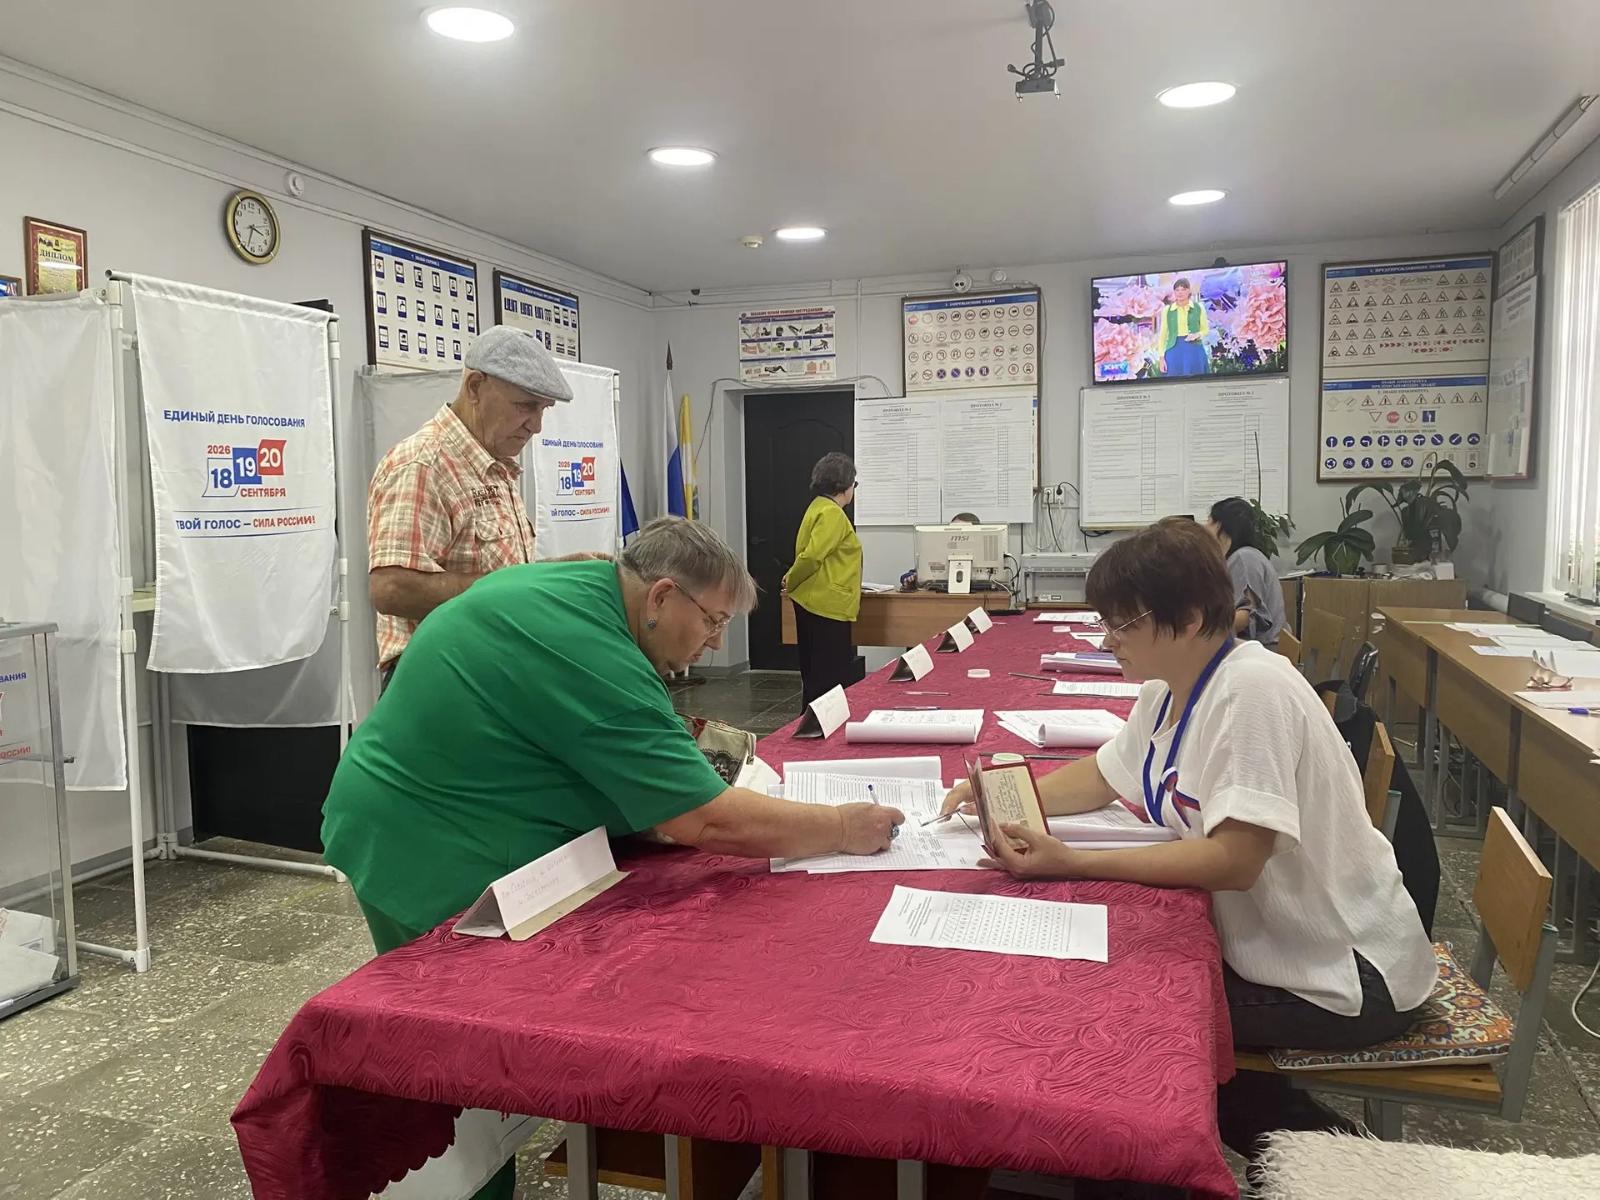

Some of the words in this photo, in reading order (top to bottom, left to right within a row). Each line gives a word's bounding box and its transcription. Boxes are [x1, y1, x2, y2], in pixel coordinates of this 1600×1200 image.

[40, 249, 74, 263] ДИПЛОМ
[163, 409, 215, 423] ЕДИНЫЙ
[217, 413, 245, 425] ДЕНЬ
[207, 445, 231, 455] 2026
[562, 440, 577, 448] ДЕНЬ
[210, 468, 233, 488] 18
[236, 457, 256, 477] 19
[259, 448, 281, 467] 20
[560, 477, 571, 490] 18
[572, 469, 582, 482] 19
[582, 462, 594, 475] 20
[240, 488, 286, 497] СЕНТЯБРЯ
[559, 509, 576, 517] ГОЛОС
[175, 518, 201, 530] ТВОЙ
[204, 520, 241, 529] ГОЛОС
[253, 518, 275, 528] СИЛА
[278, 515, 316, 526] РОССИИ!
[0, 746, 31, 759] ОССИИ!
